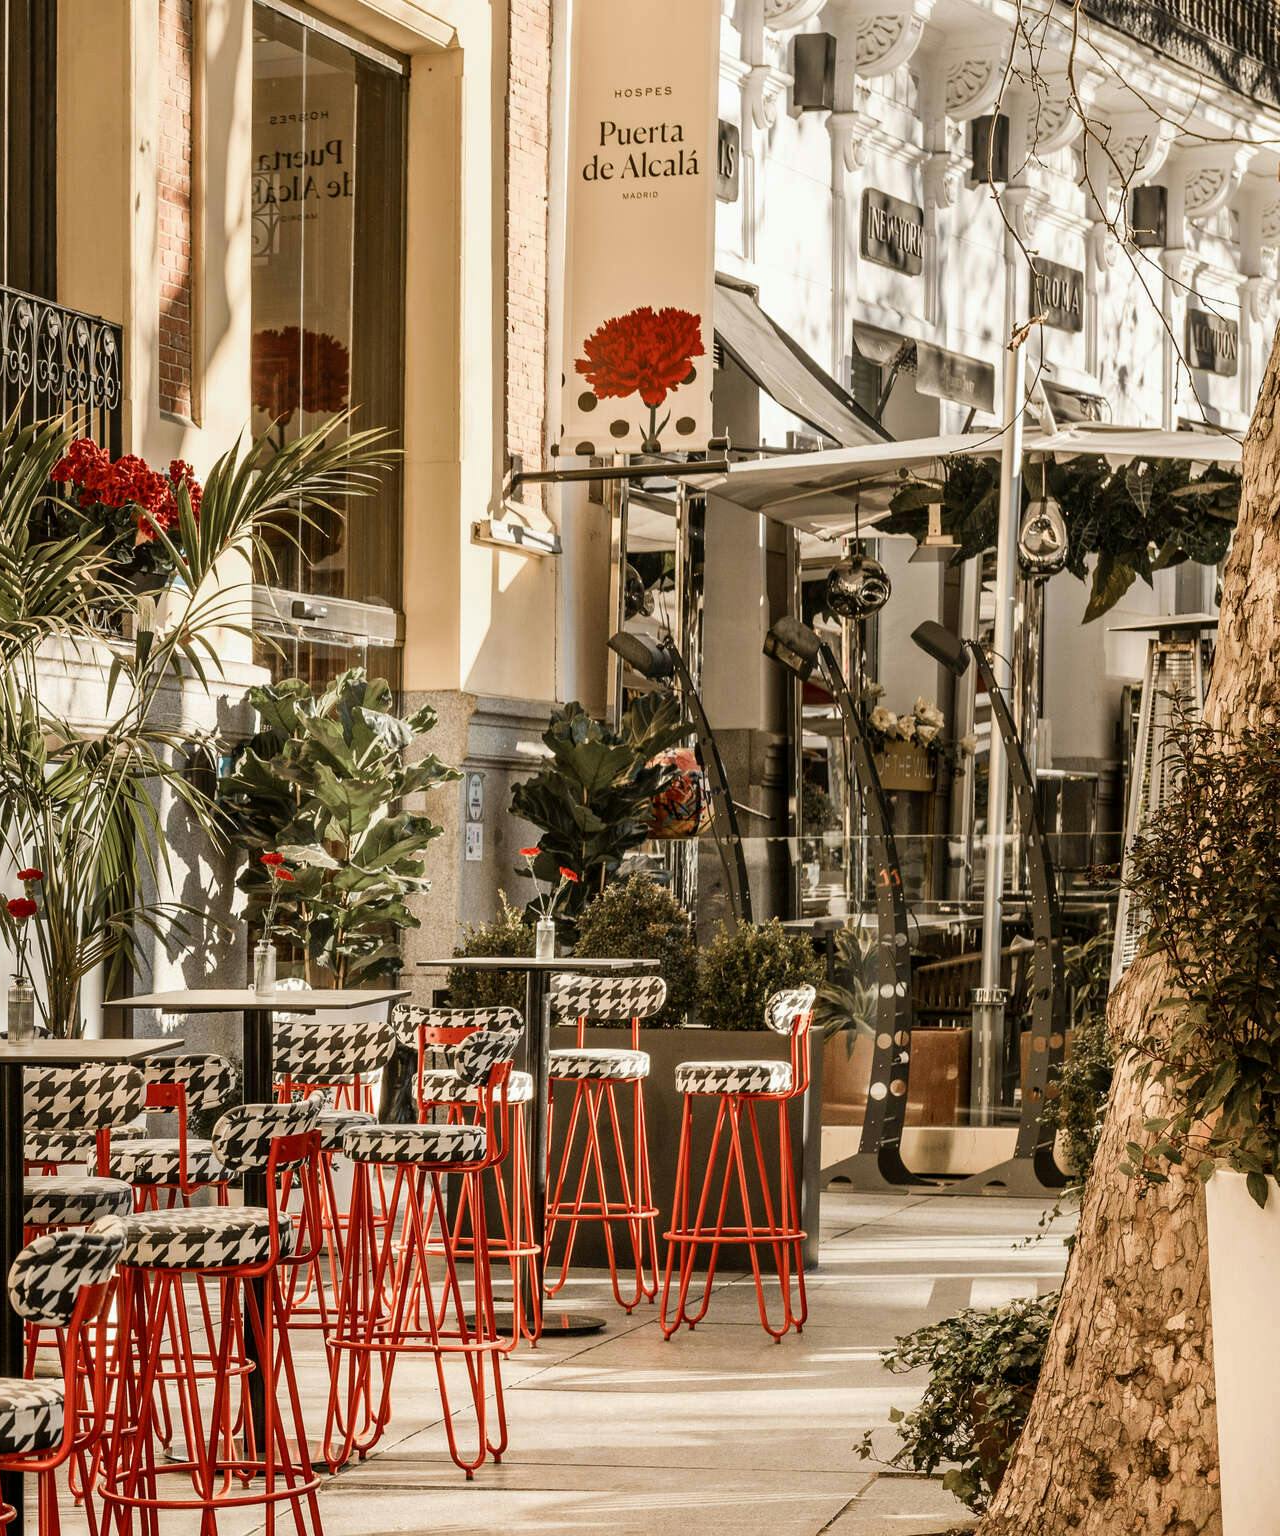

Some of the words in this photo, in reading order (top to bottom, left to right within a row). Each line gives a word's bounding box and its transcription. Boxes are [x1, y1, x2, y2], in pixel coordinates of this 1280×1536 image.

[614, 86, 673, 98] HOSPES
[600, 121, 684, 146] Puerta
[582, 154, 614, 181] de
[621, 150, 699, 179] Alcalá
[622, 191, 659, 200] MADRID
[1044, 275, 1080, 314] ROMA
